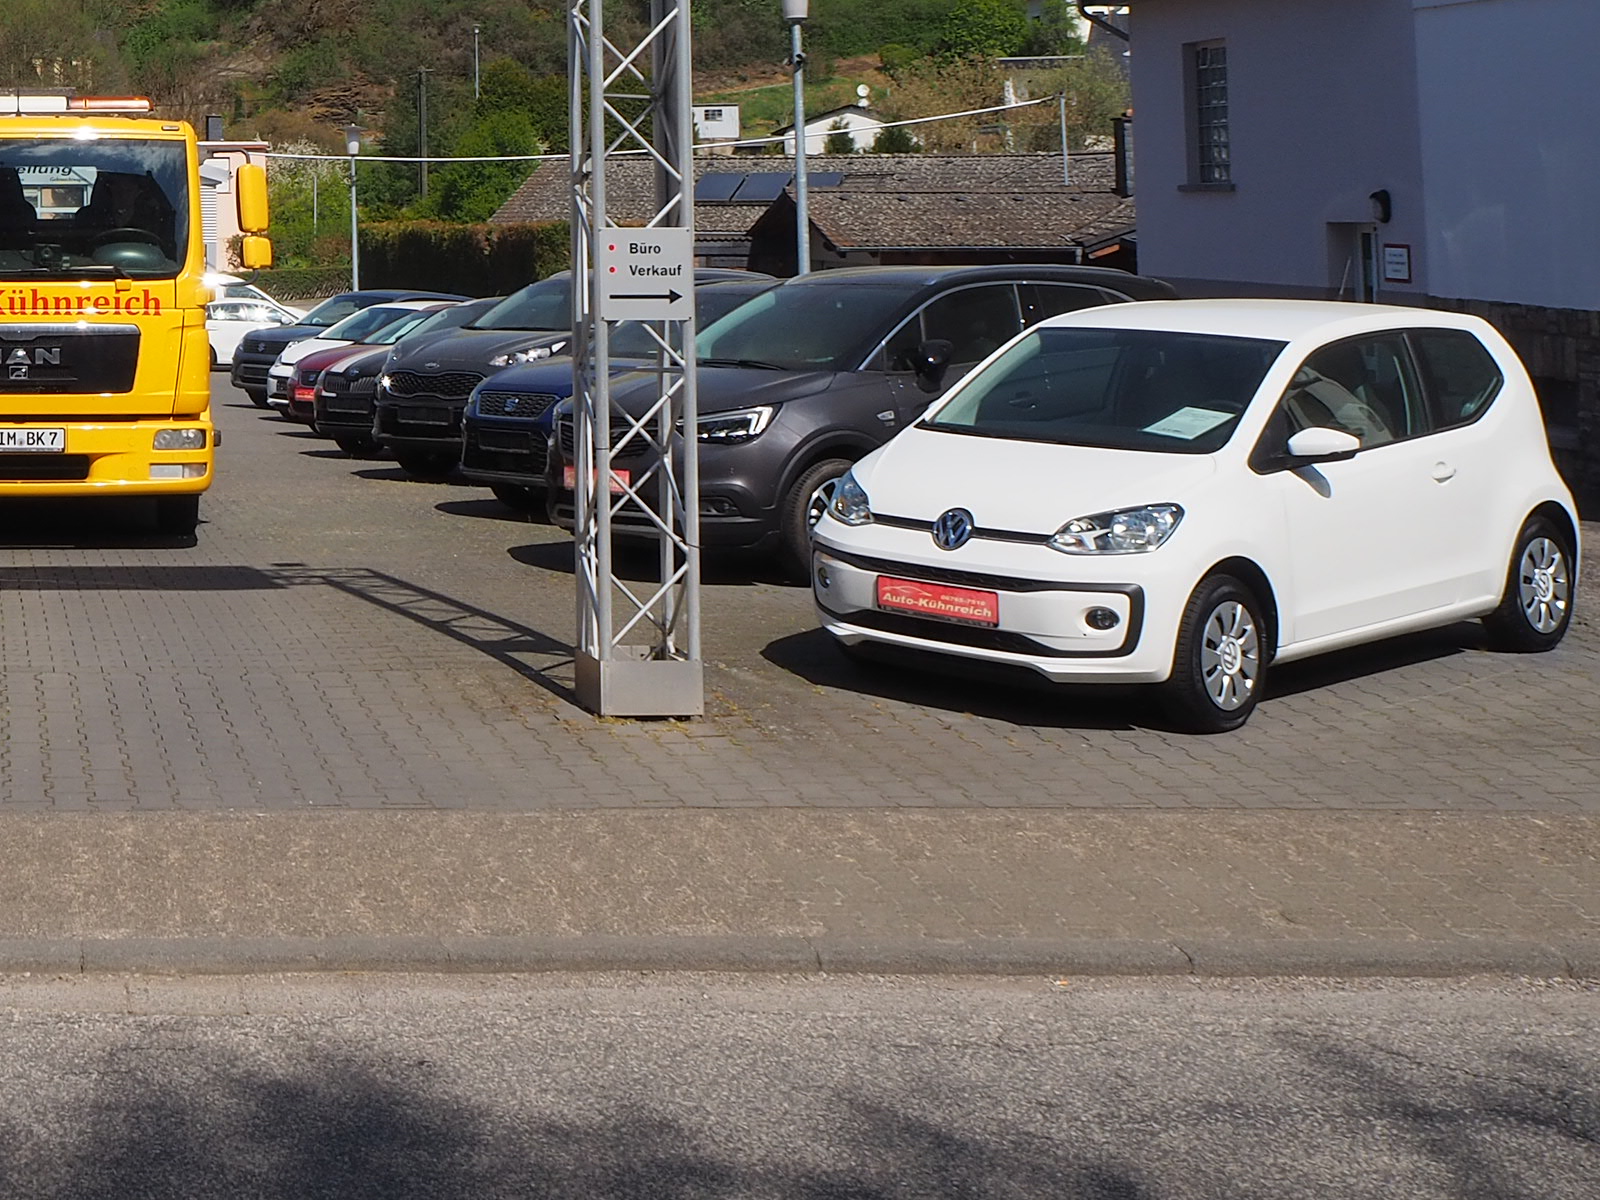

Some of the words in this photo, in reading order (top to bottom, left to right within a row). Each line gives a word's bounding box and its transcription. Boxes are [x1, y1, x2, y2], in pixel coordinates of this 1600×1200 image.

[629, 242, 661, 254] Büro
[629, 264, 682, 276] Verkauf
[882, 592, 993, 618] Auto-Kühnreich
